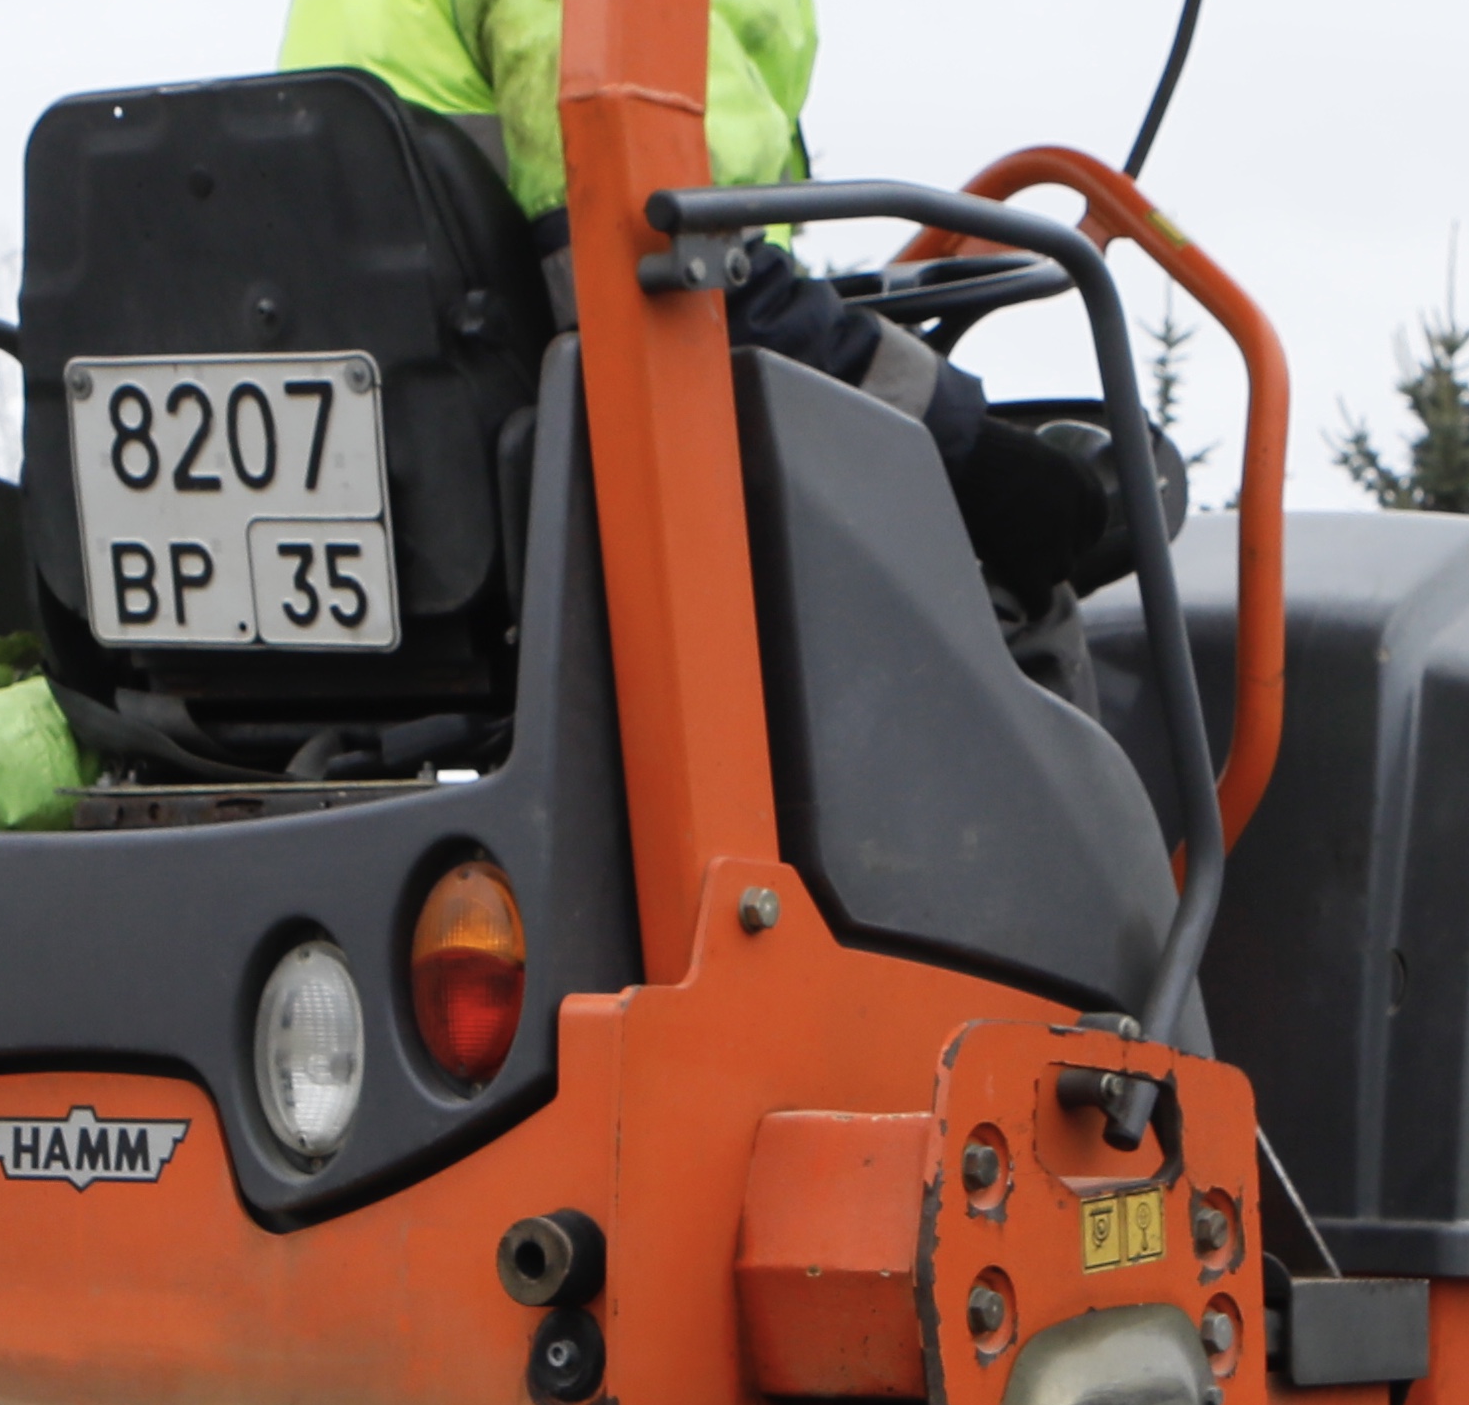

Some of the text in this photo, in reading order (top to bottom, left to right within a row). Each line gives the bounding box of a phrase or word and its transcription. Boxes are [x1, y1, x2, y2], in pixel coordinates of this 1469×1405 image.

[108, 379, 334, 491] 8207
[111, 541, 368, 628] ВР 35
[12, 1126, 151, 1171] HAMM
